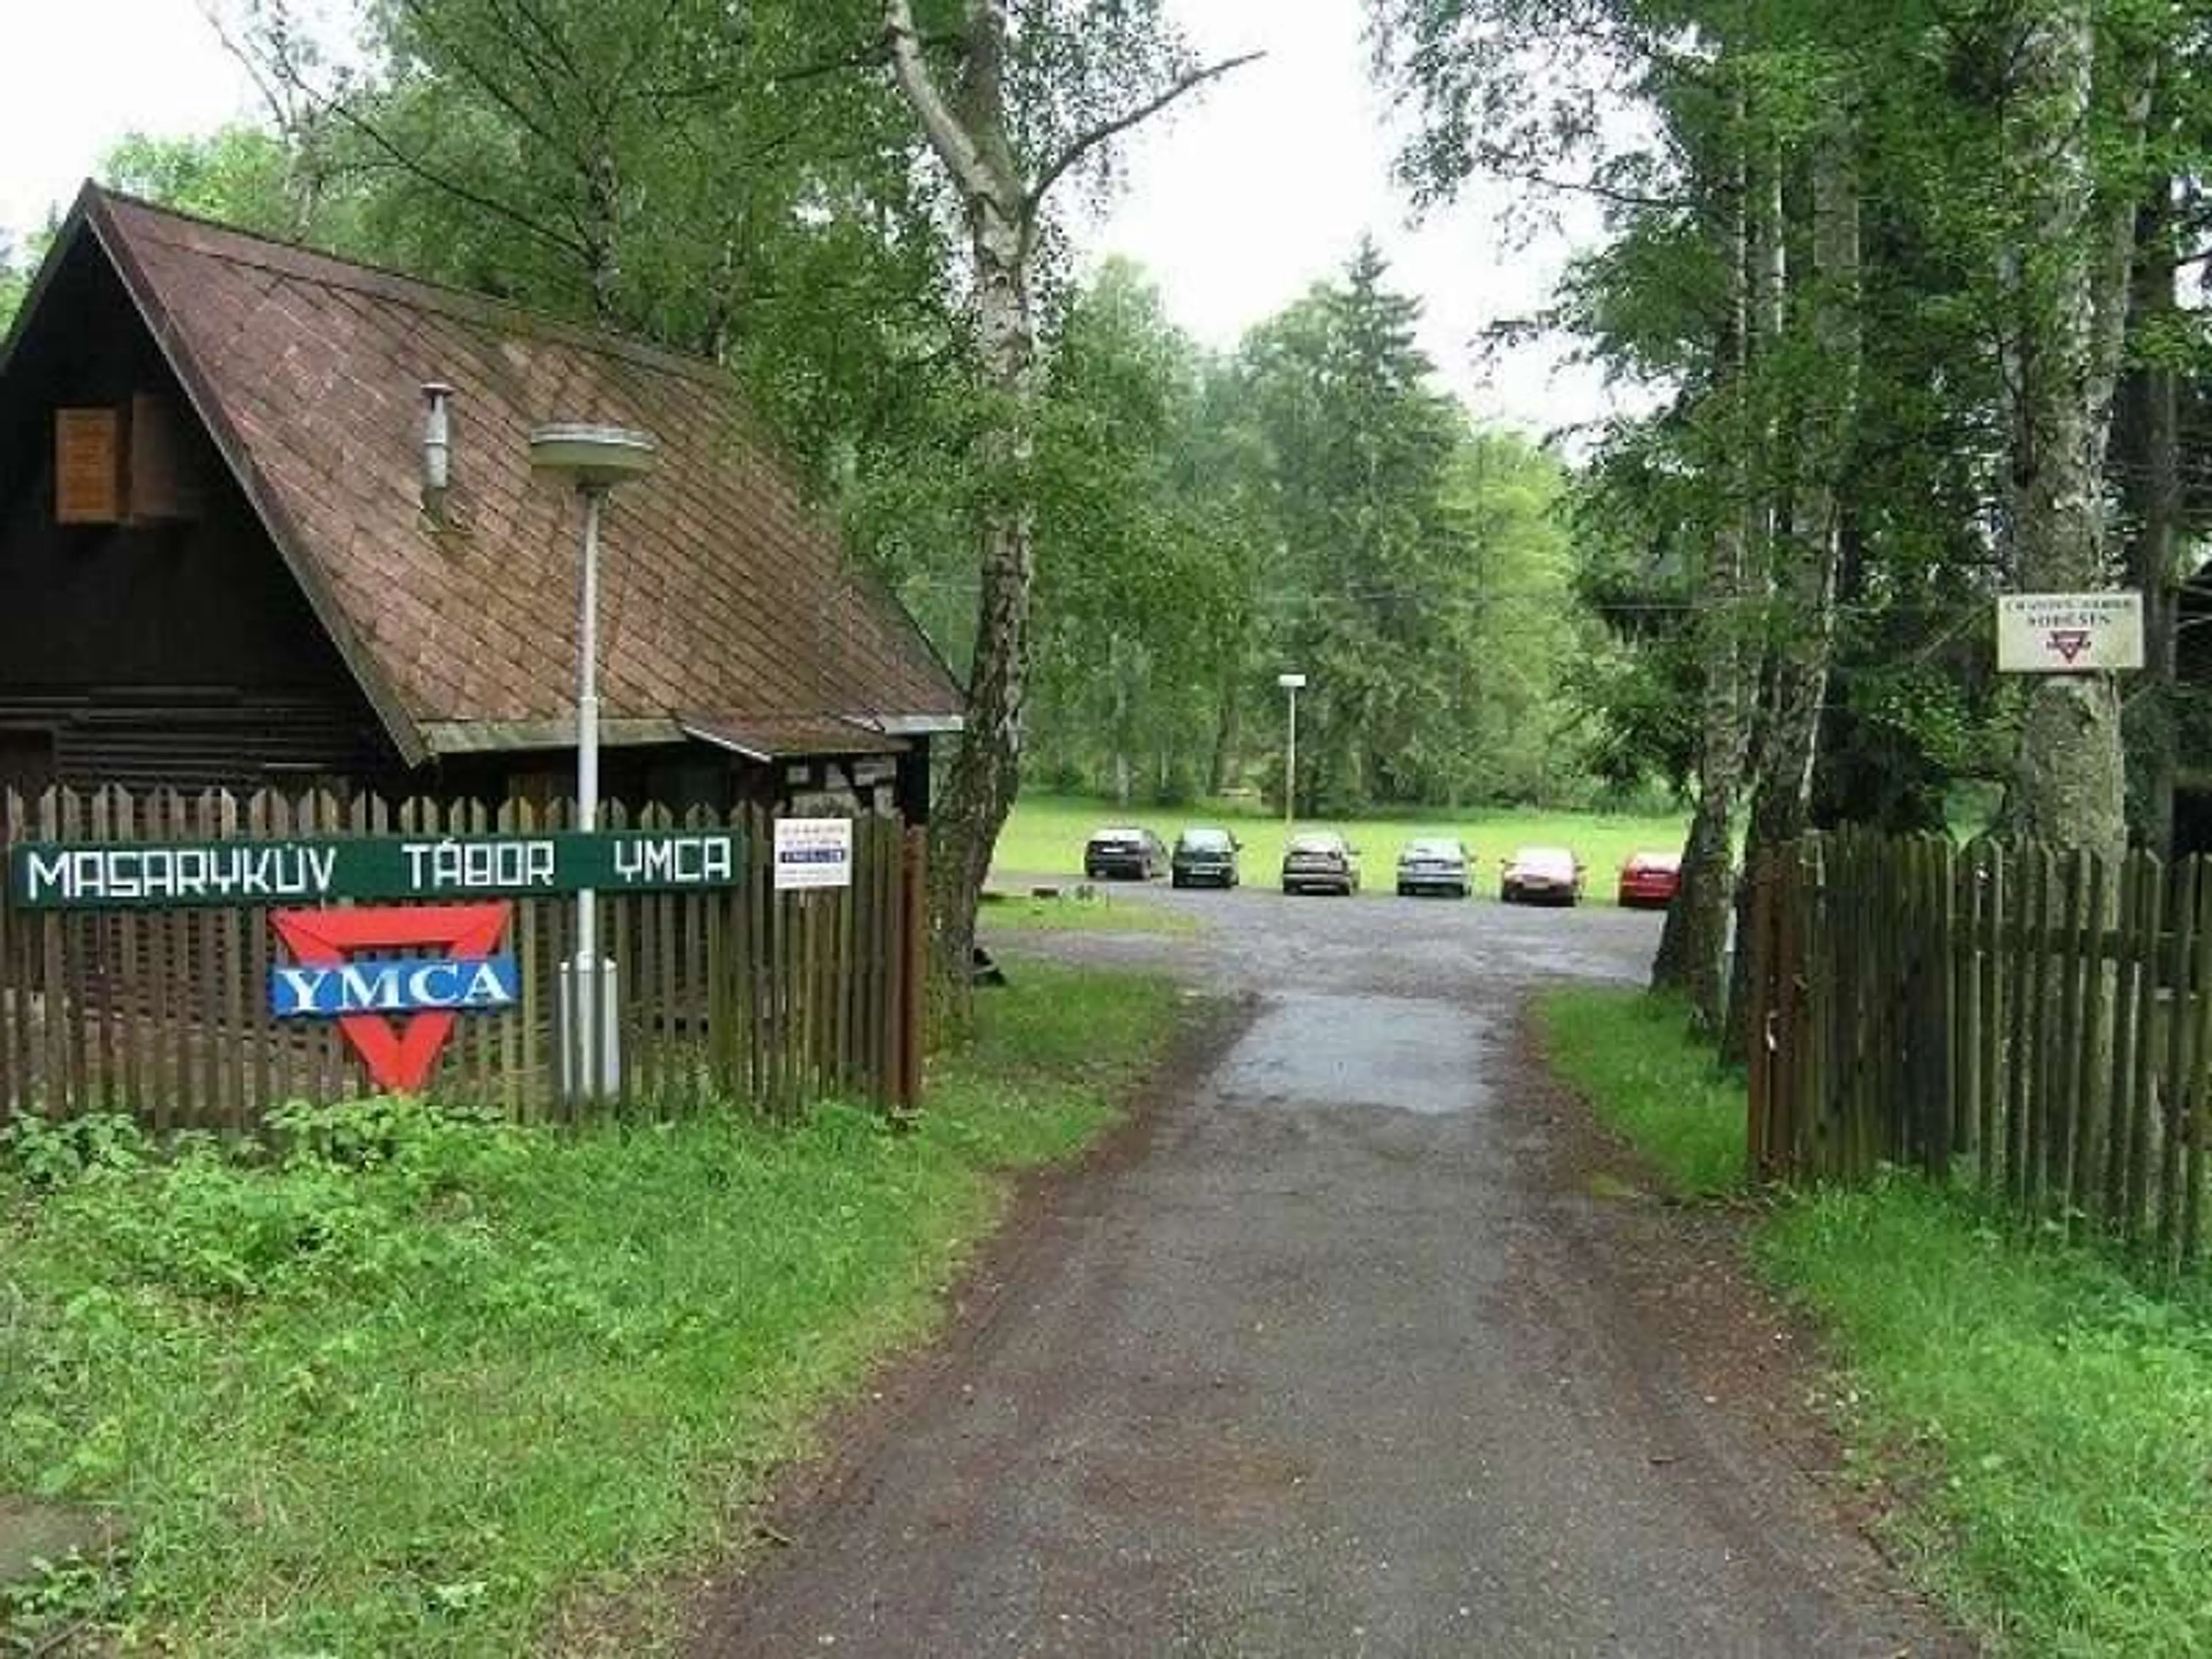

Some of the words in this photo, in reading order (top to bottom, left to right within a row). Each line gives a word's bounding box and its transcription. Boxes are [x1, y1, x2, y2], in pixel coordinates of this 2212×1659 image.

[402, 836, 555, 889] TÁBOR
[614, 837, 732, 882] YMCA
[276, 961, 512, 1012] YMCA
